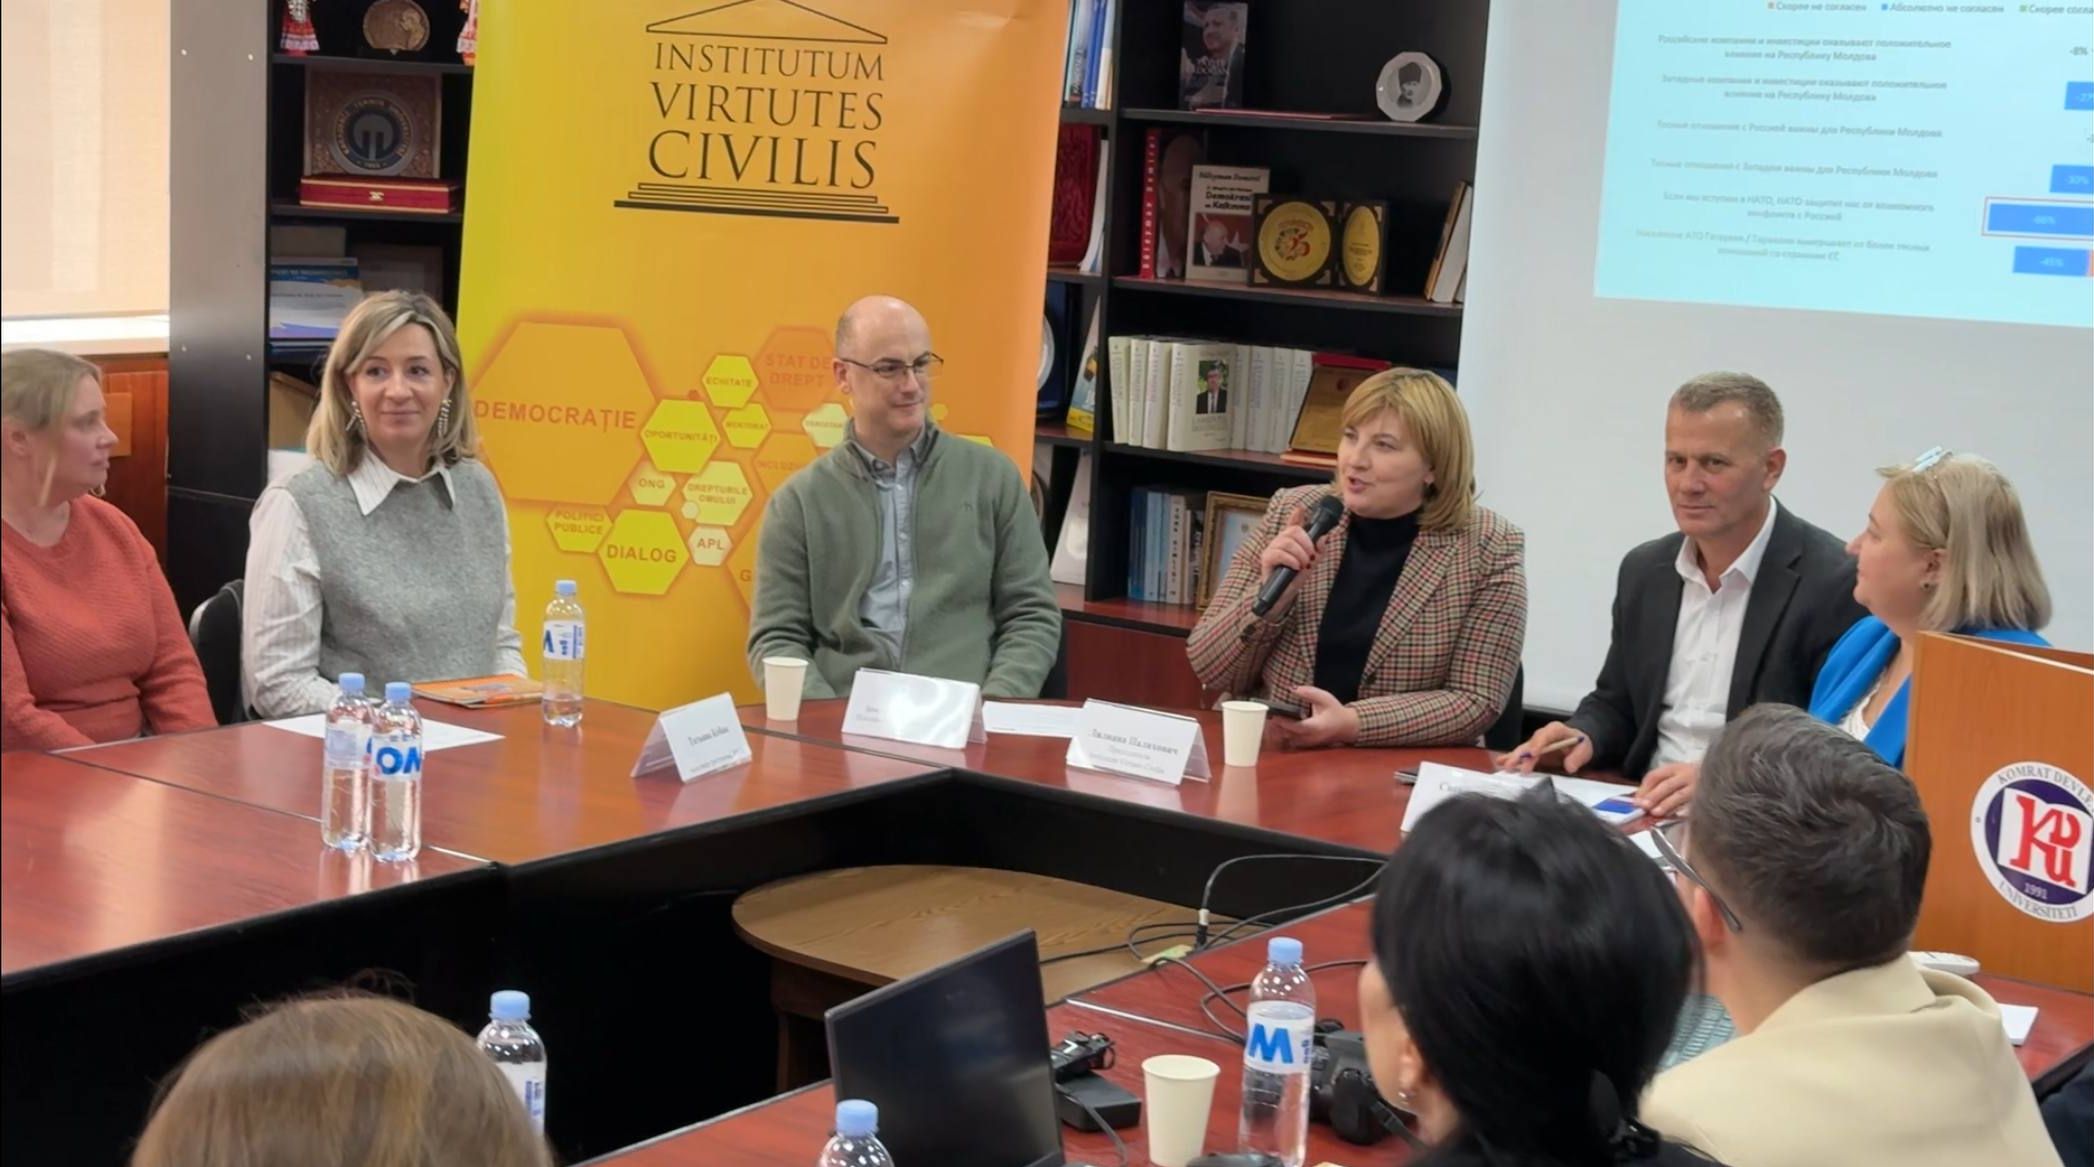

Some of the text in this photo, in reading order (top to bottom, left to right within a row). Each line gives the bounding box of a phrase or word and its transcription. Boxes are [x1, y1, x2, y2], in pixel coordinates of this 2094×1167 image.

[2029, 4, 2065, 15] Скорее
[655, 42, 885, 81] INSTITUTUM
[650, 82, 883, 131] VIRTUTES
[648, 129, 877, 189] CIVILIS
[766, 353, 808, 367] STAT
[768, 372, 825, 387] DREPT
[473, 400, 637, 433] DEMOCRAȚIE
[639, 477, 665, 488] ONG
[687, 482, 748, 496] DREPTURILE
[554, 522, 603, 535] PUBLICE
[697, 538, 724, 551] APL
[606, 544, 677, 563] DIALOG
[1998, 764, 2050, 785] KOMRAT
[2023, 882, 2049, 900] 1991
